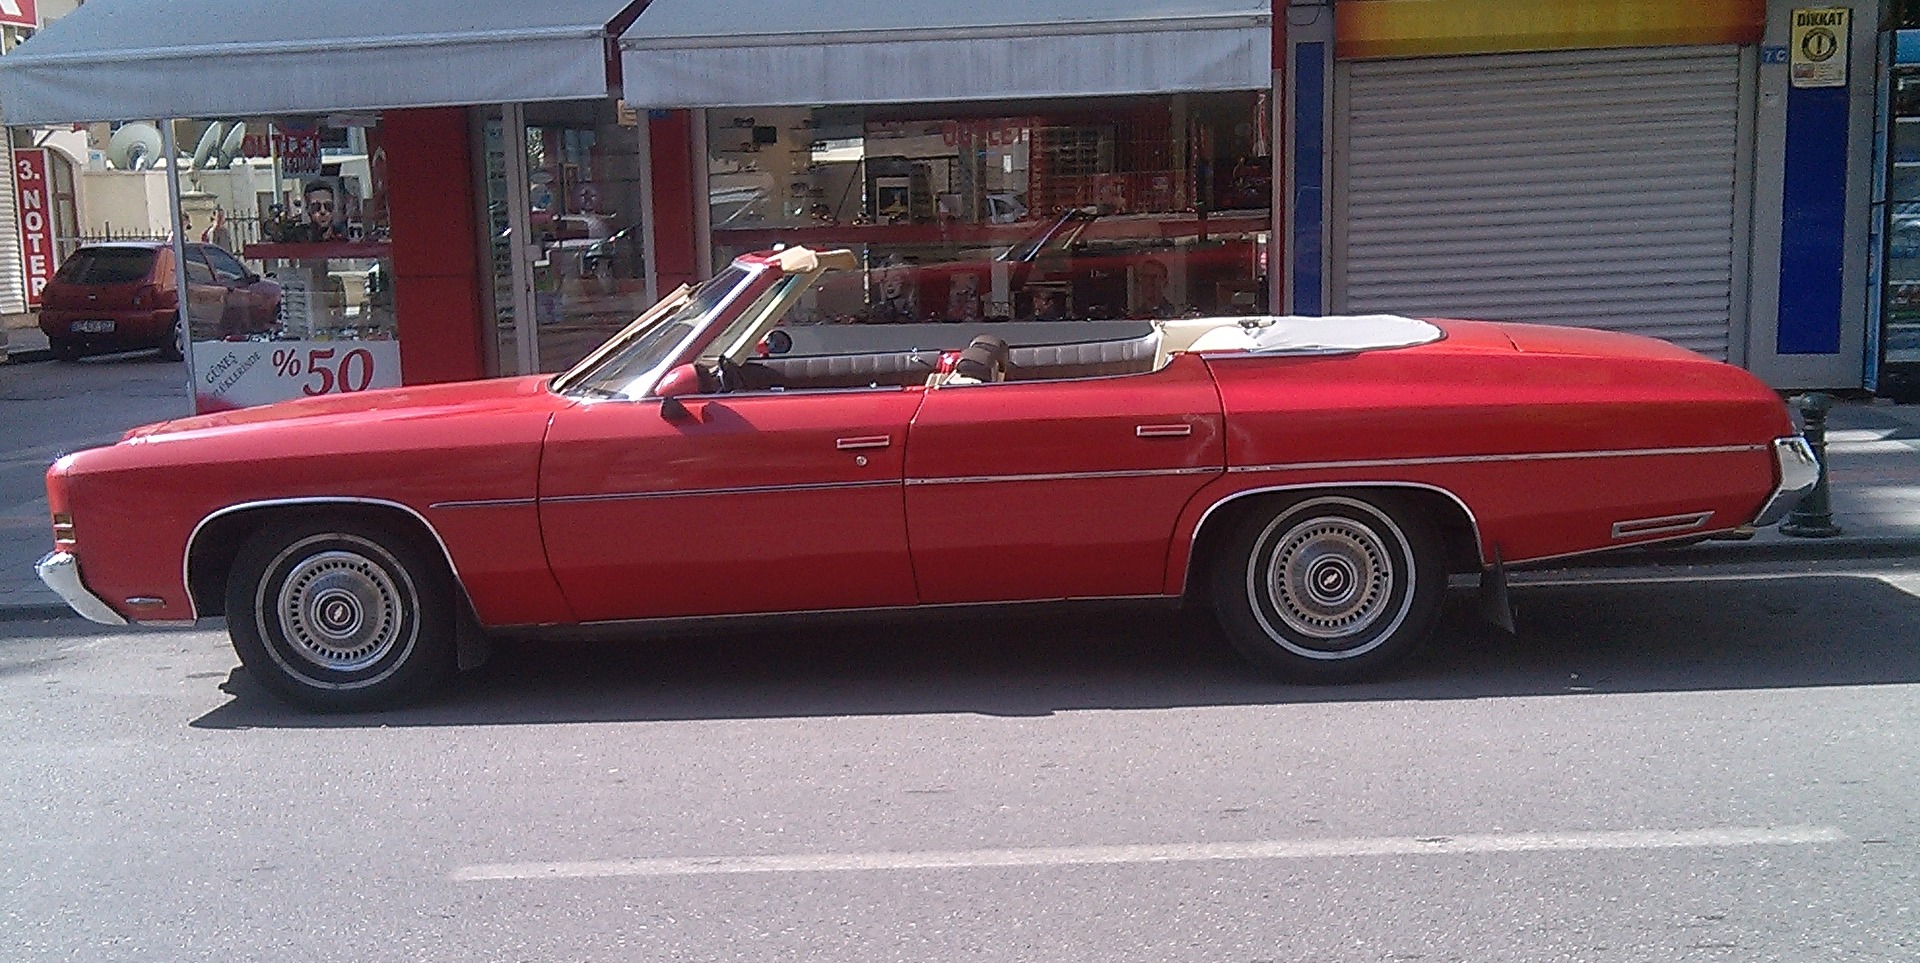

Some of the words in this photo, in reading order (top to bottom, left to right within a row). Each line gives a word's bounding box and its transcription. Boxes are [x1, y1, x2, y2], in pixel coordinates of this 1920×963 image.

[18, 159, 41, 181] 3.
[22, 188, 48, 297] NOTER
[205, 351, 238, 385] GÜNEŞ
